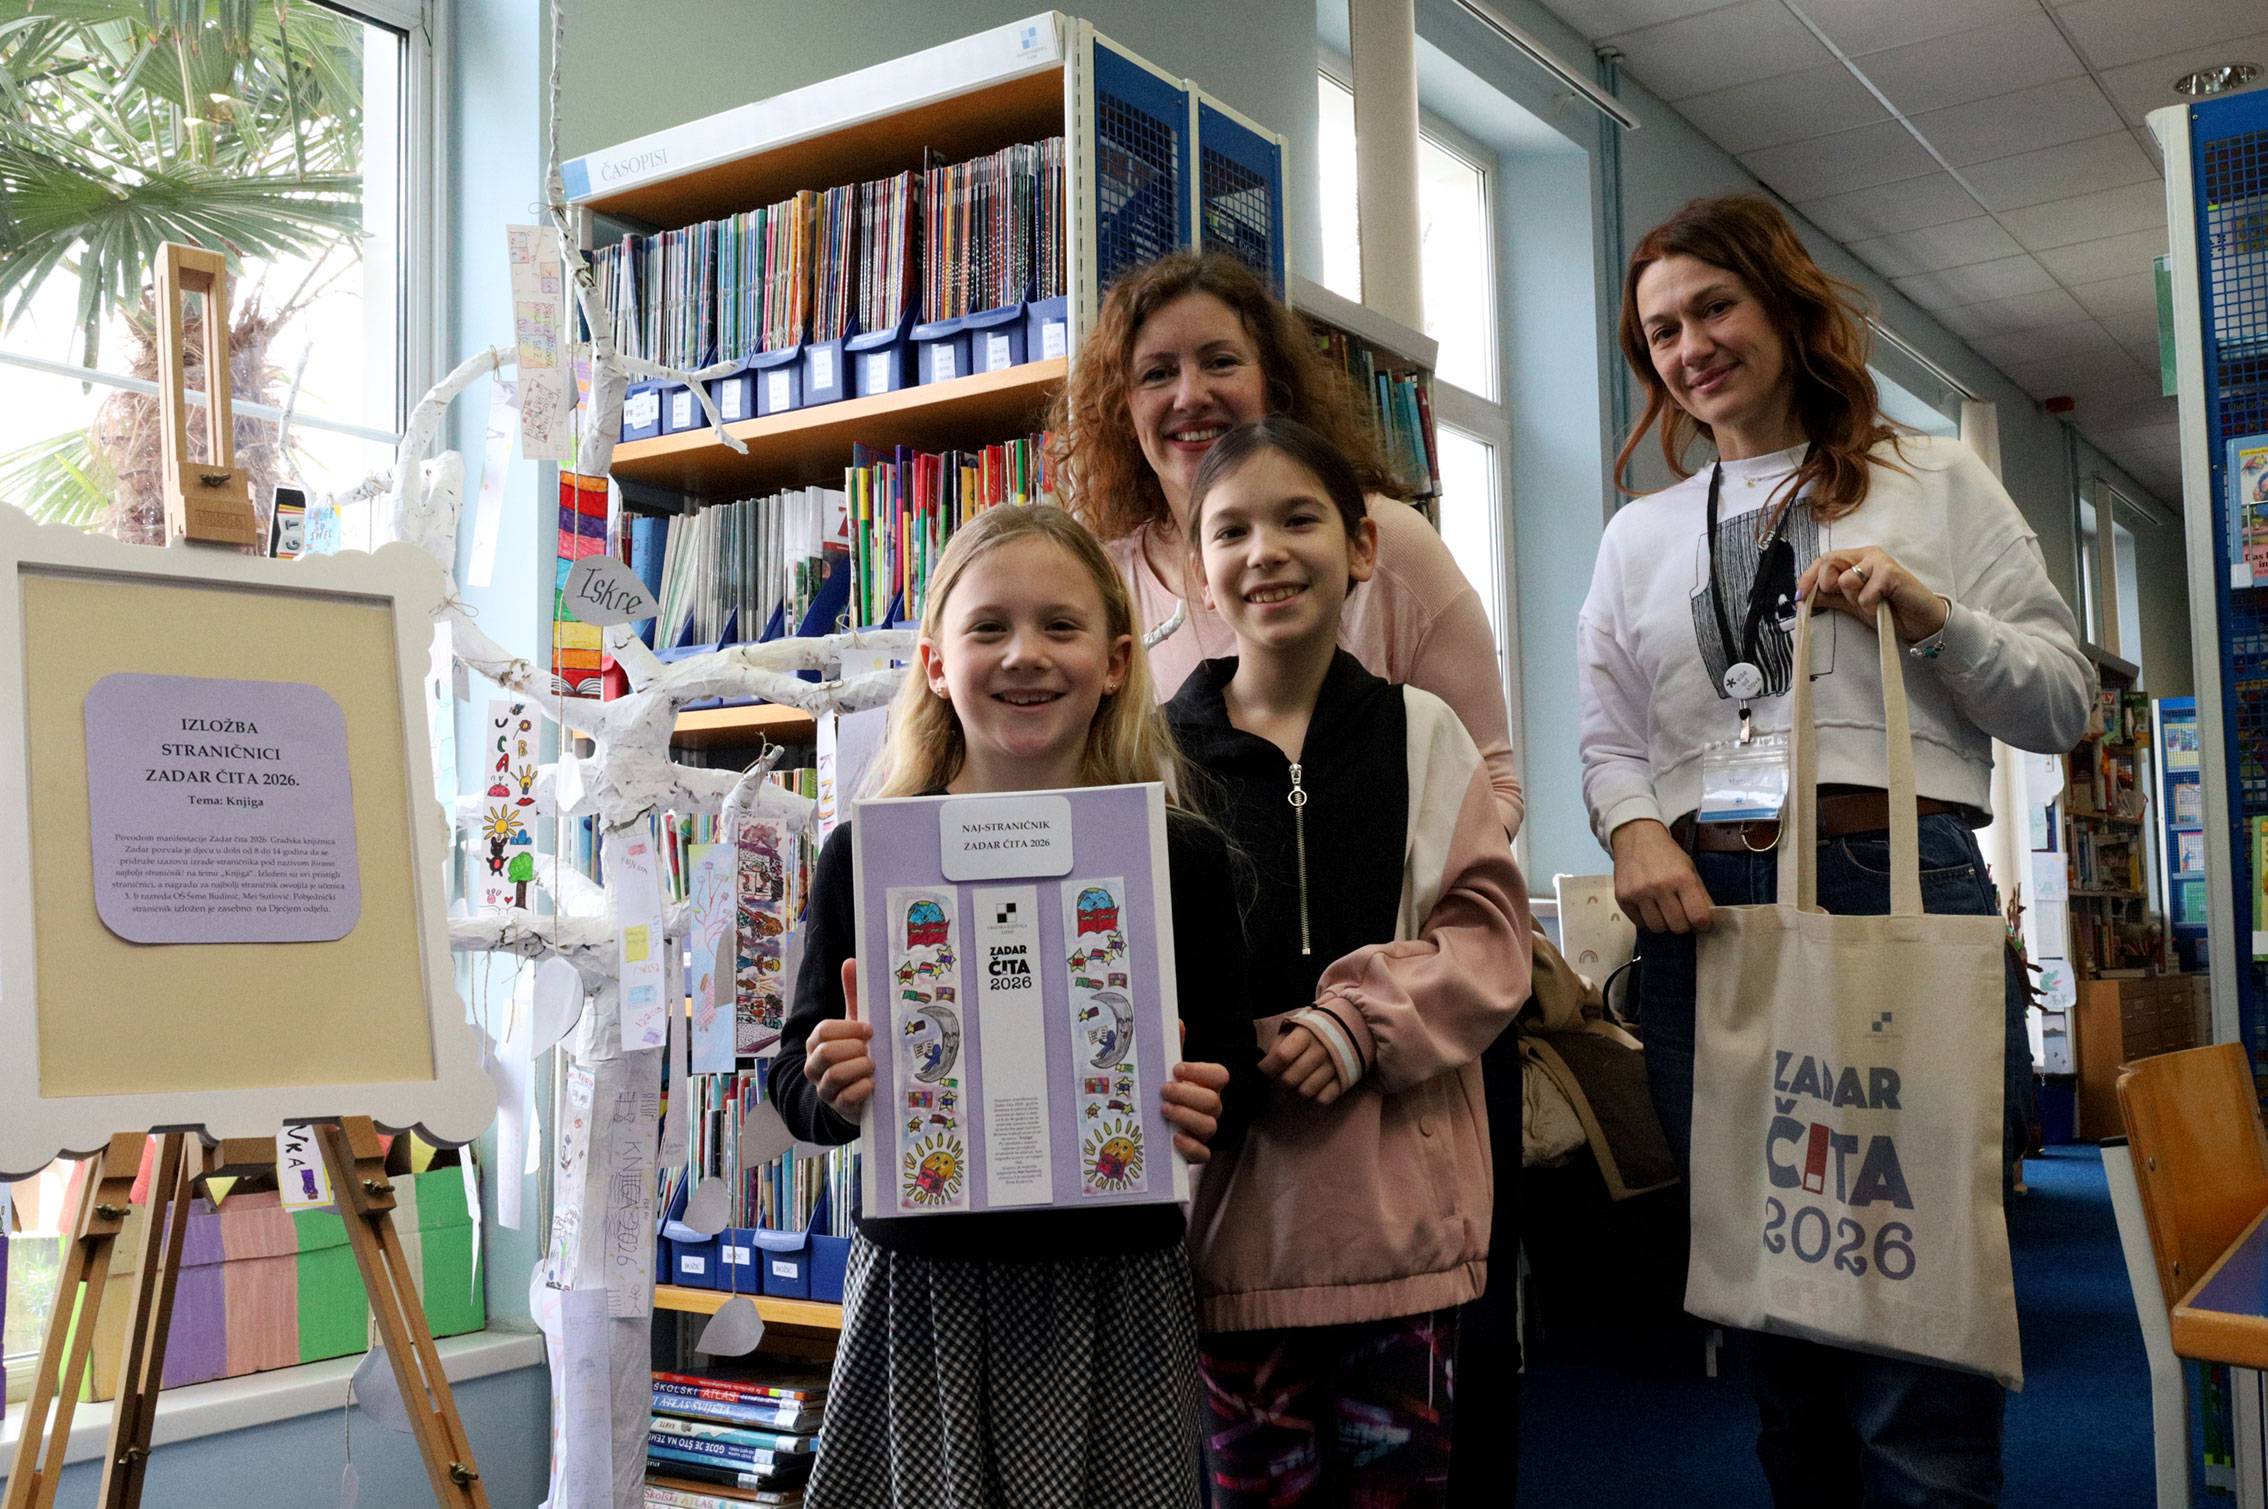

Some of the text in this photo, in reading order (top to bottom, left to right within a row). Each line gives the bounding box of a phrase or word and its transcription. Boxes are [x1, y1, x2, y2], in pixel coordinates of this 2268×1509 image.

[601, 147, 668, 181] ČASOPISI
[576, 568, 643, 615] Iskre
[181, 718, 259, 734] IZLOŽBA
[161, 743, 281, 760] STRANIČNICI
[145, 769, 300, 787] ZADAR ČITA 2026.
[188, 795, 264, 809] Tema: Knjiga
[962, 820, 1050, 833] NAJ-STRANIČNIK
[964, 838, 1050, 851] ZADAR ČITA 2026
[989, 944, 1027, 956] ZADAR
[988, 956, 1031, 976] ČITA
[990, 976, 1032, 991] 2026
[1773, 1048, 1903, 1110] ZADAR
[1765, 1095, 1915, 1210] ČITA
[1762, 1195, 1917, 1281] 2026
[652, 1381, 698, 1396] ŠKOLSKI
[702, 1388, 737, 1402] ATLAS
[667, 1435, 678, 1445] NA
[679, 1437, 694, 1451] ŠTO
[695, 1440, 704, 1451] JE
[705, 1442, 725, 1455] GDJE
